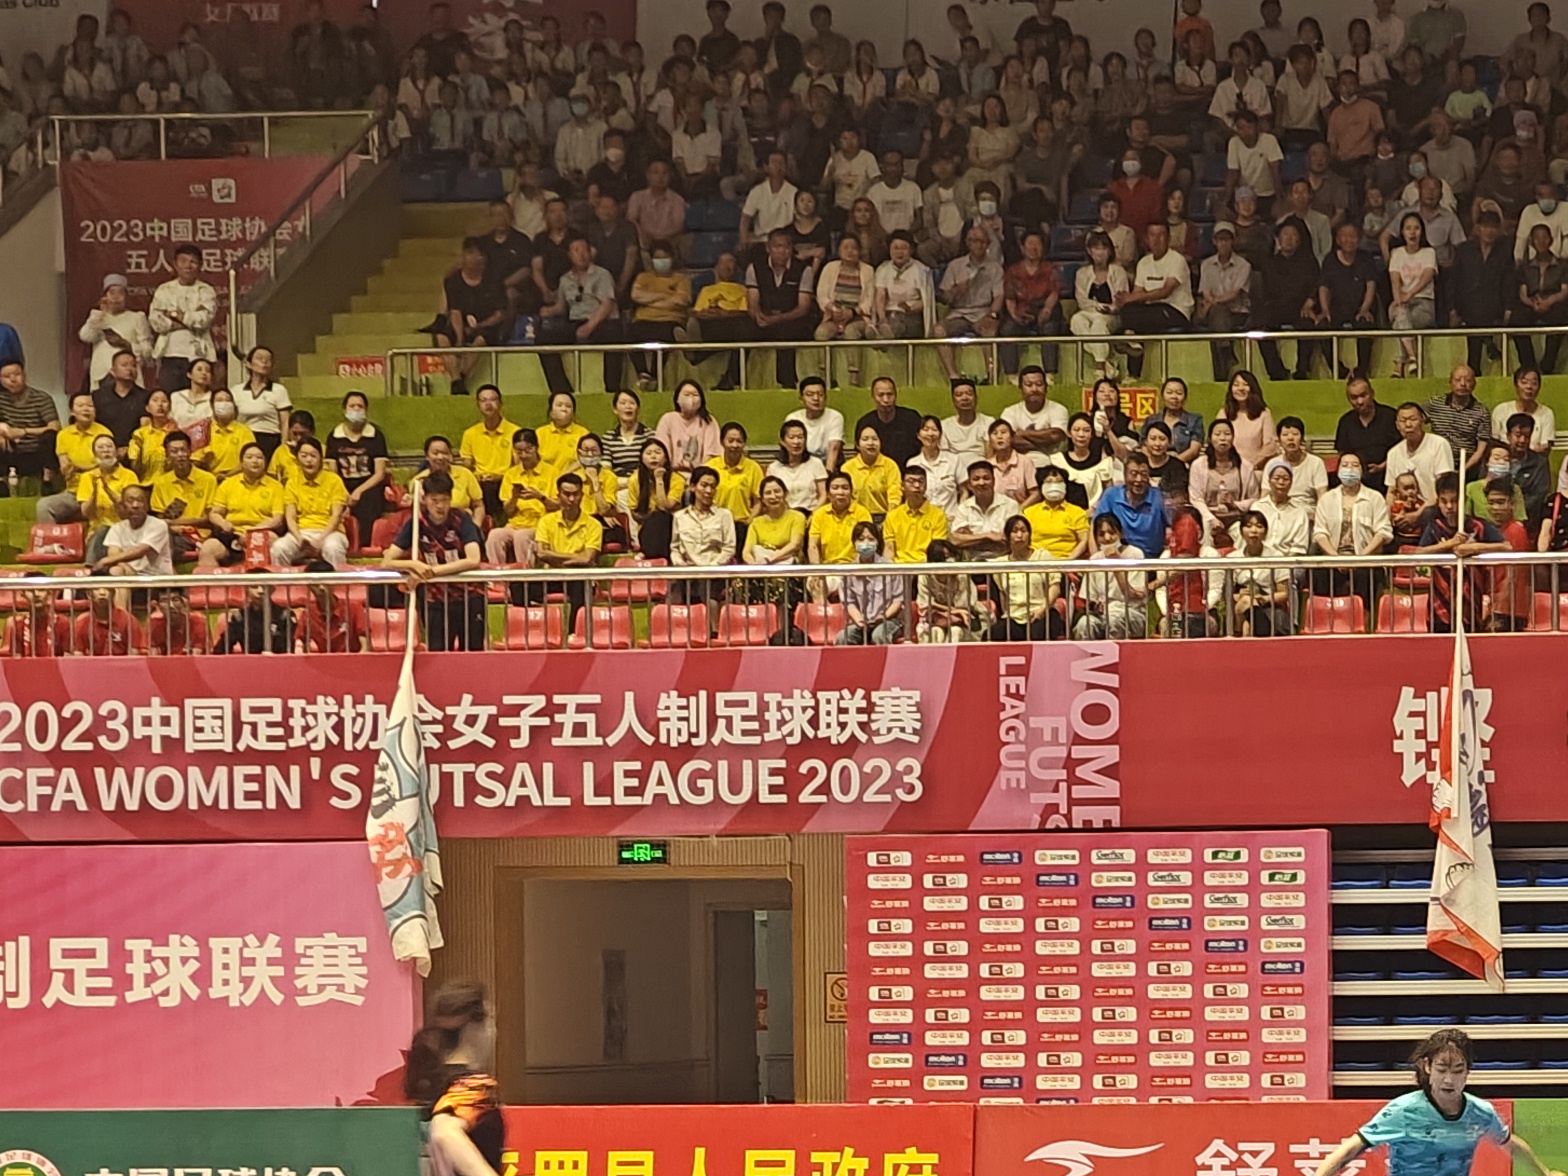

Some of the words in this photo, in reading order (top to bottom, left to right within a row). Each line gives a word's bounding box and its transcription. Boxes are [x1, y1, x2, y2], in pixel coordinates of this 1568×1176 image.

[999, 656, 1026, 790] LEAGUE
[0, 766, 89, 813] CFA
[94, 758, 361, 812] WOMEN'S
[584, 758, 789, 807] LEAGUE
[797, 756, 924, 803] 2023
